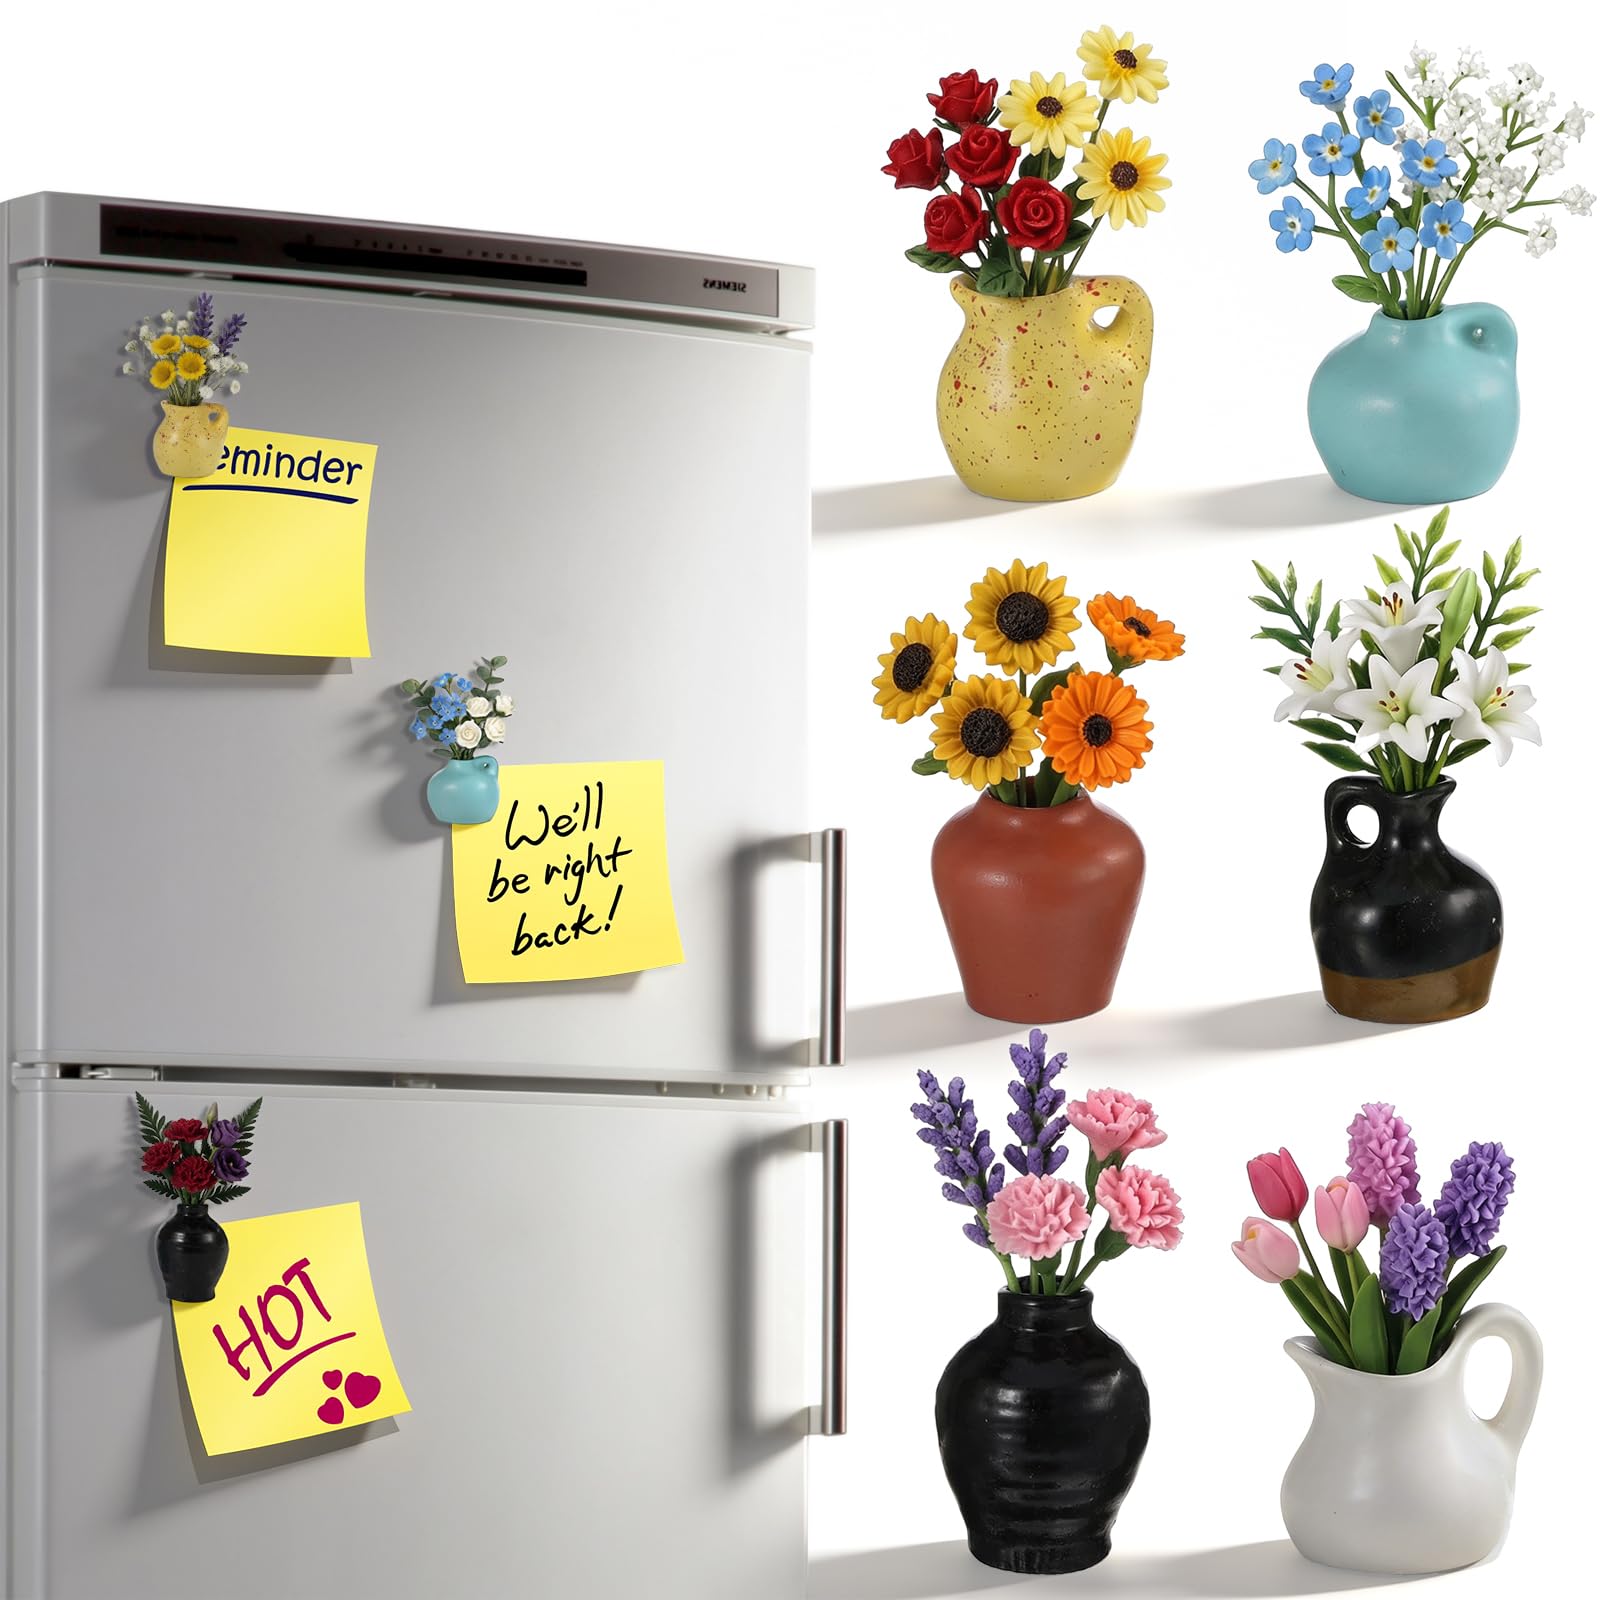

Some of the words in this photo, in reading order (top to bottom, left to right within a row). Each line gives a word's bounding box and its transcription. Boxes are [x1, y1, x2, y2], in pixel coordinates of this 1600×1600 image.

[216, 443, 363, 486] eminder
[505, 781, 604, 851] We'll
[487, 858, 531, 903] be
[544, 836, 633, 906] right
[511, 884, 624, 956] back!
[212, 1257, 332, 1381] HOT
